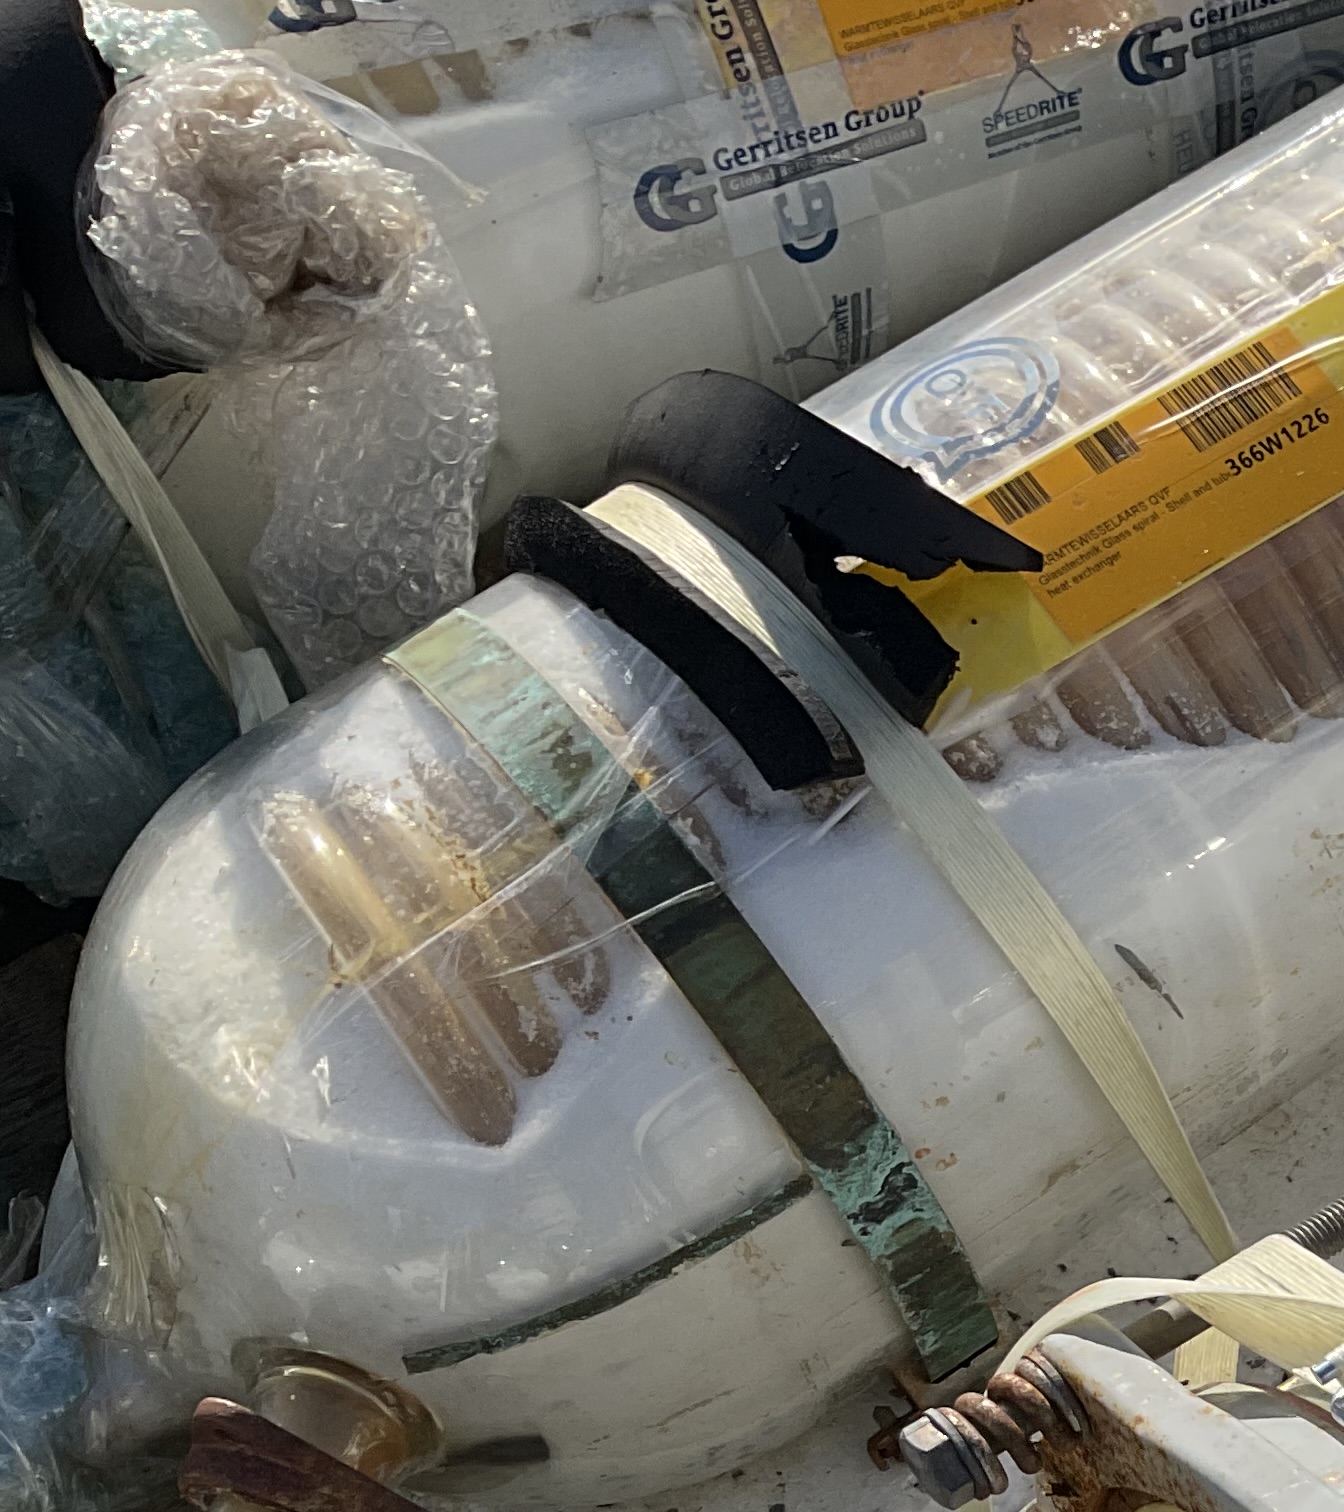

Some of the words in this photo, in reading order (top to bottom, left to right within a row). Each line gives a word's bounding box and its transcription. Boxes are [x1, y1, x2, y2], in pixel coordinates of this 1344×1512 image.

[712, 121, 839, 172] Gerritsen
[844, 95, 923, 132] Group
[982, 91, 1080, 133] SPEEDRITE
[729, 166, 775, 191] Global
[853, 126, 918, 156] Solutions
[1224, 407, 1330, 476] 366W1226
[1038, 546, 1101, 586] Glasstechnik
[1102, 529, 1132, 549] Glass
[1132, 511, 1160, 534] spiral
[1165, 492, 1193, 513] Shell
[1193, 480, 1213, 498] and
[1044, 502, 1148, 566] RMTEWISSELAARS
[1148, 486, 1171, 508] QVF
[1046, 580, 1071, 599] heat
[1072, 551, 1123, 585] exchanger
